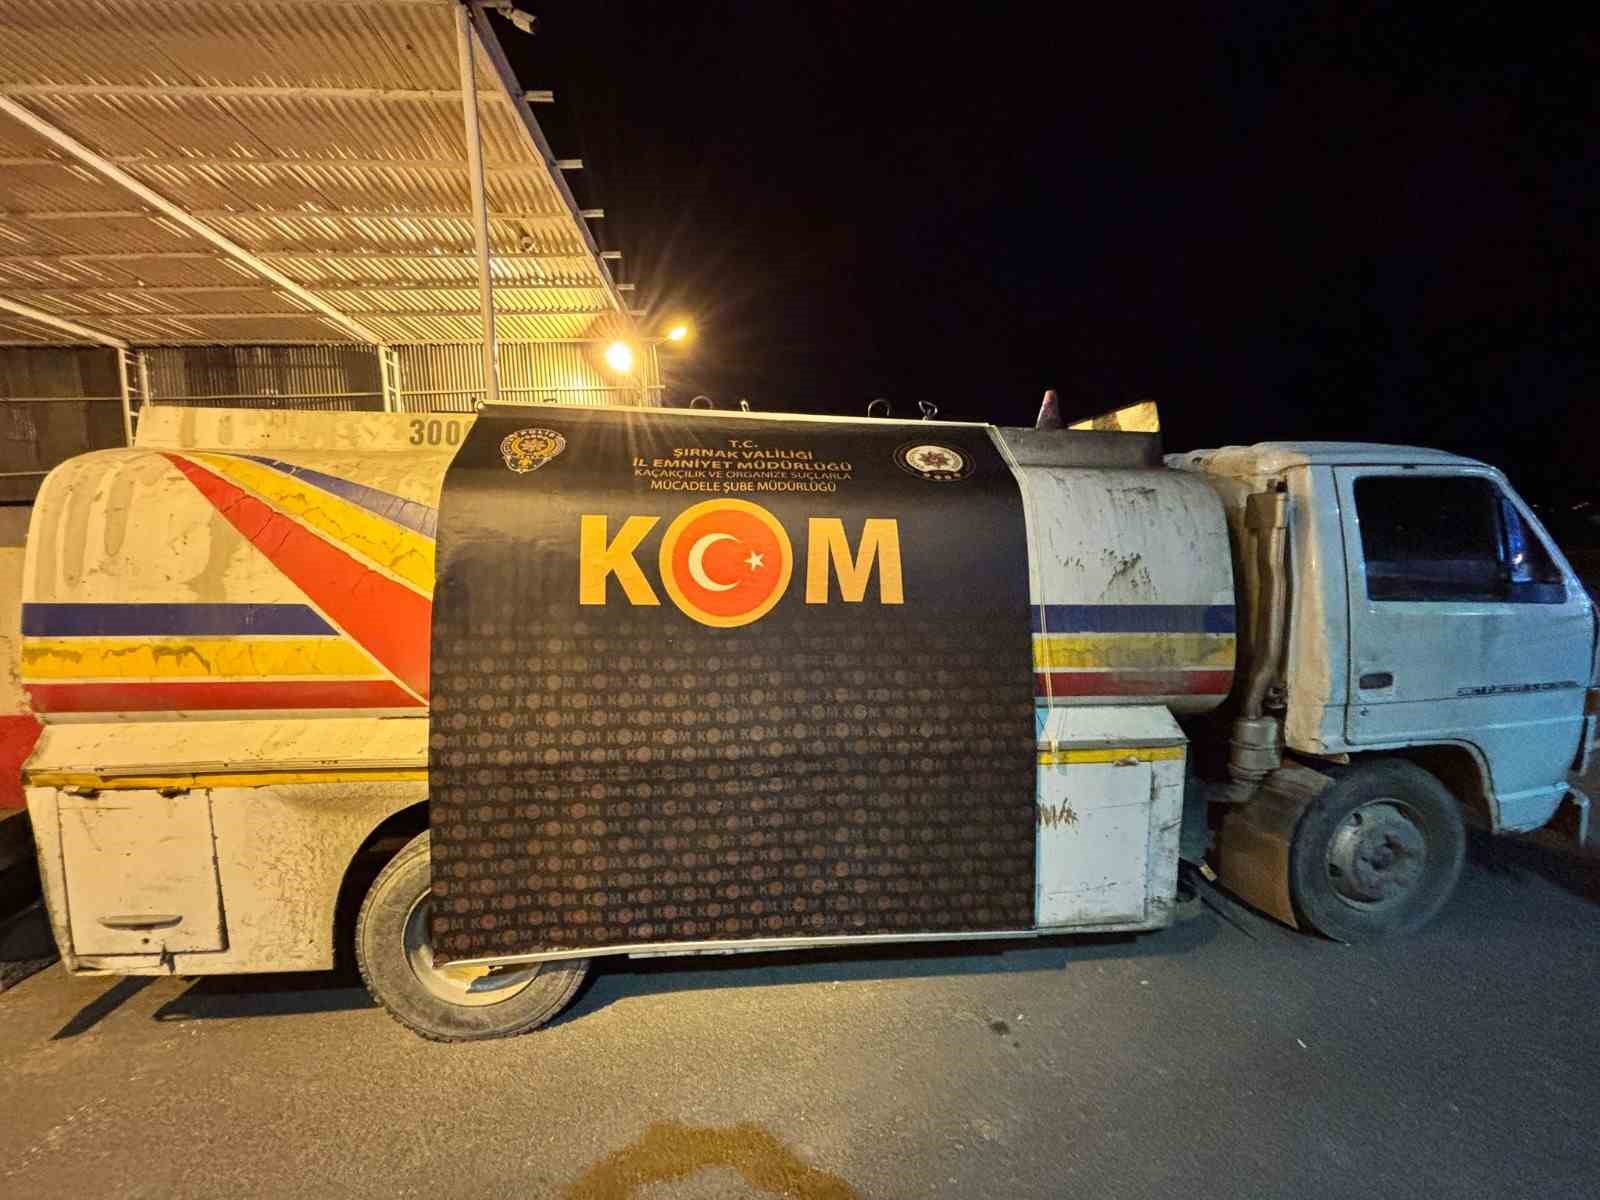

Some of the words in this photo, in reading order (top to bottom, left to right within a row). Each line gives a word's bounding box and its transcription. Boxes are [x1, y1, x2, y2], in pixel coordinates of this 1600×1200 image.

[409, 419, 473, 446] 300
[728, 440, 758, 449] T.C.
[672, 448, 738, 460] ŞIRNAK
[653, 458, 733, 469] EMNİYET
[708, 471, 723, 479] VE
[722, 481, 753, 494] ŞUBE
[579, 498, 905, 628] KOM
